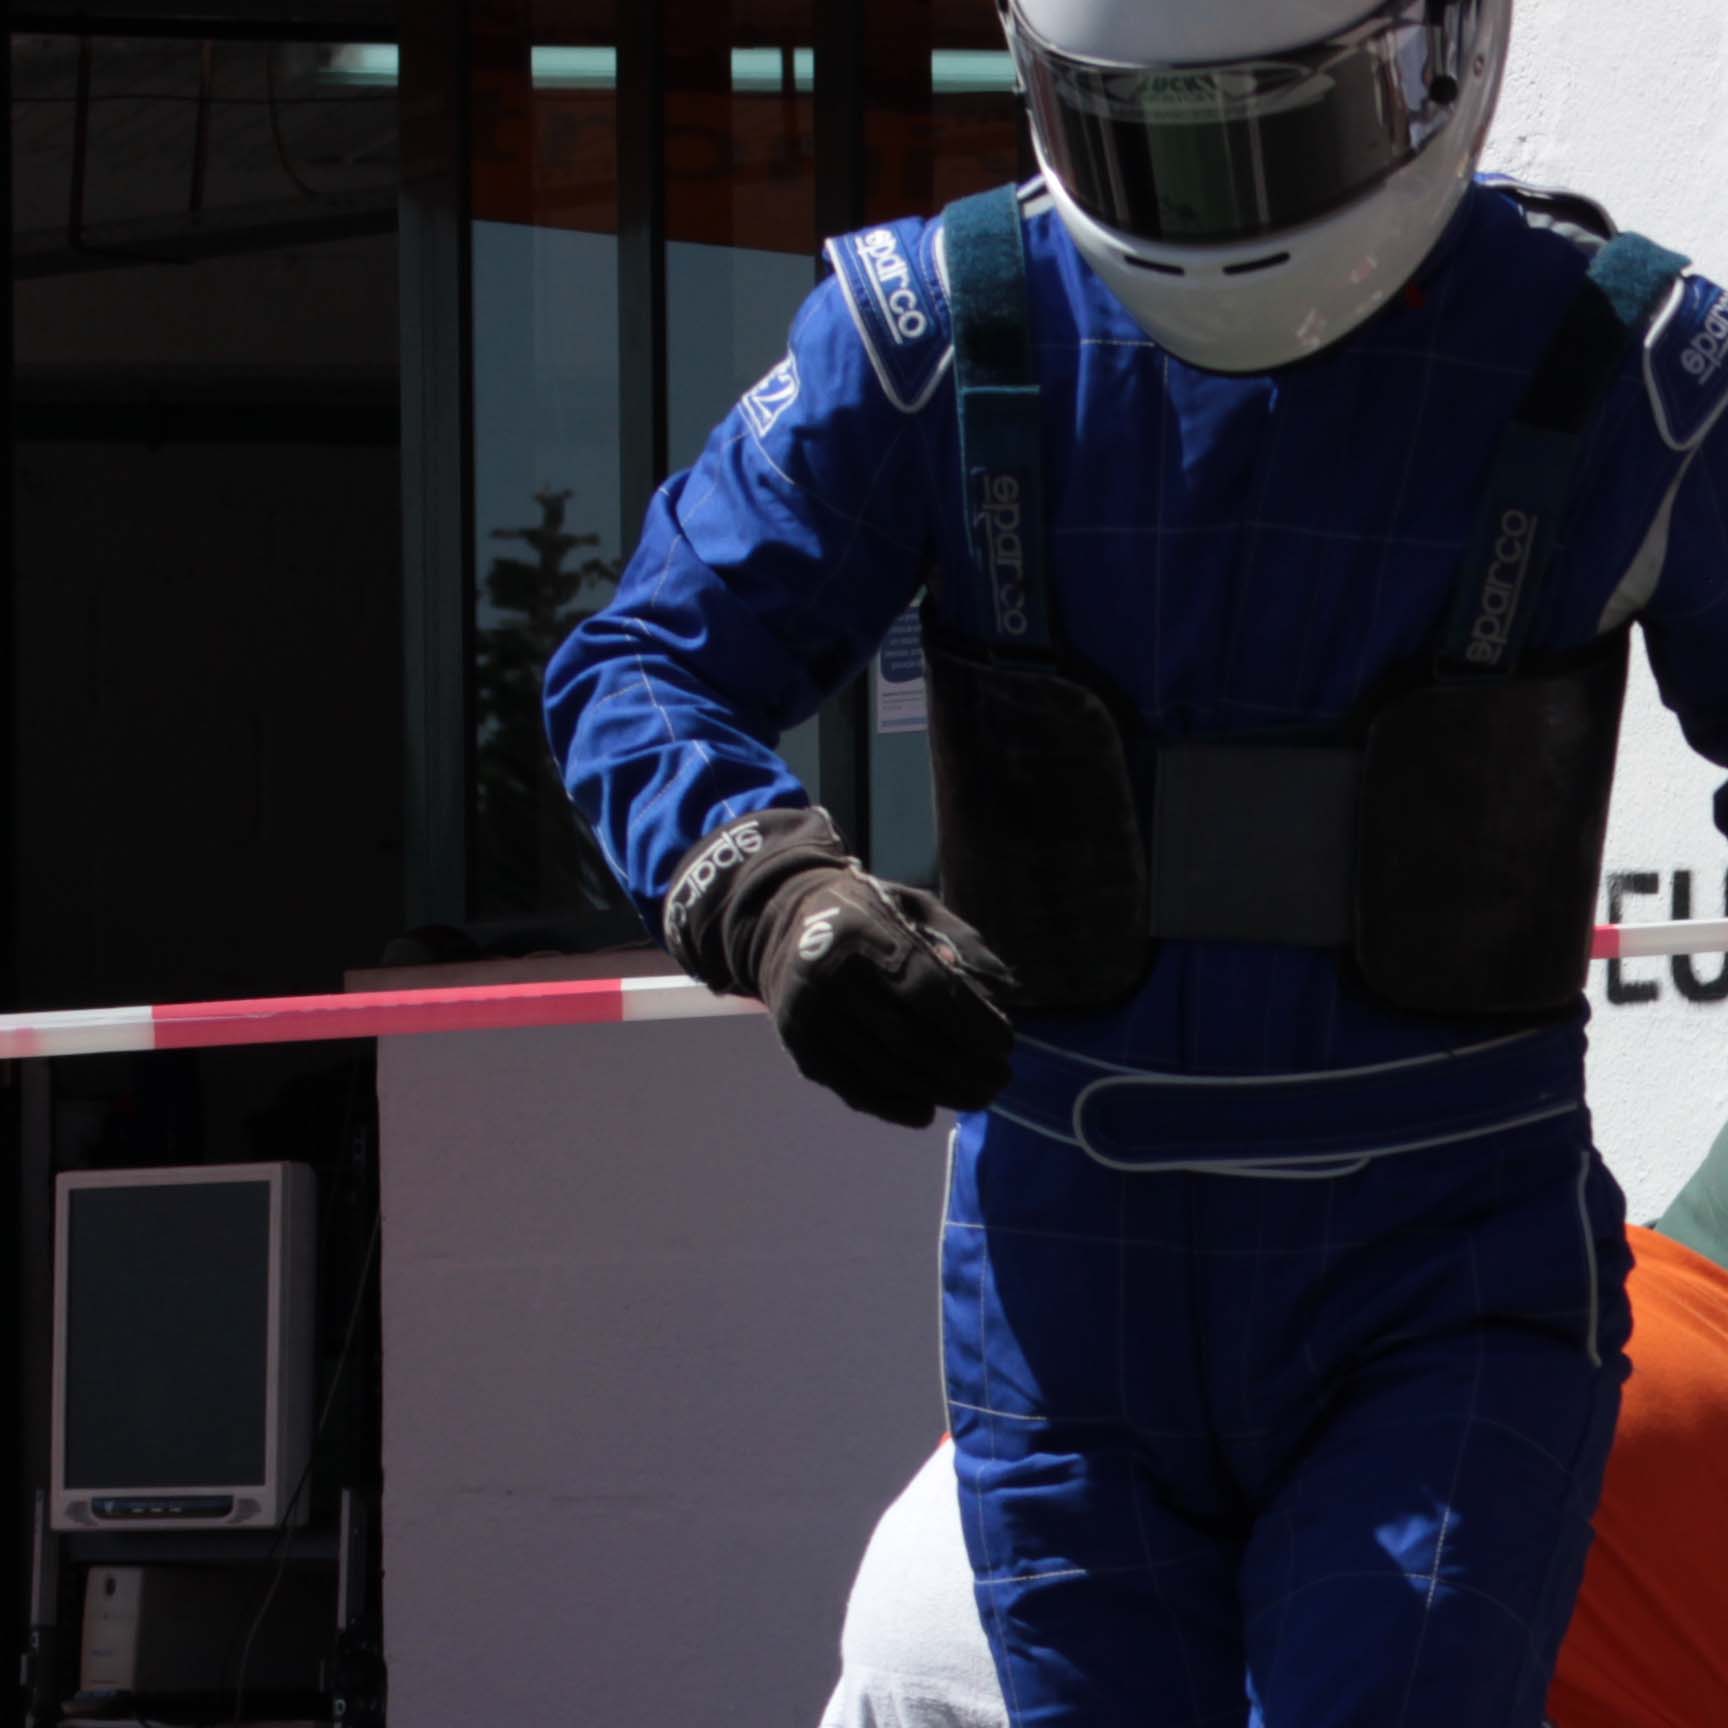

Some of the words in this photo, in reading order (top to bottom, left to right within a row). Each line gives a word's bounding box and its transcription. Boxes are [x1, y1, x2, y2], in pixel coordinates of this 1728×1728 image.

[859, 228, 928, 341] sparco
[983, 473, 1029, 637] sparco
[1465, 508, 1534, 664] sparco
